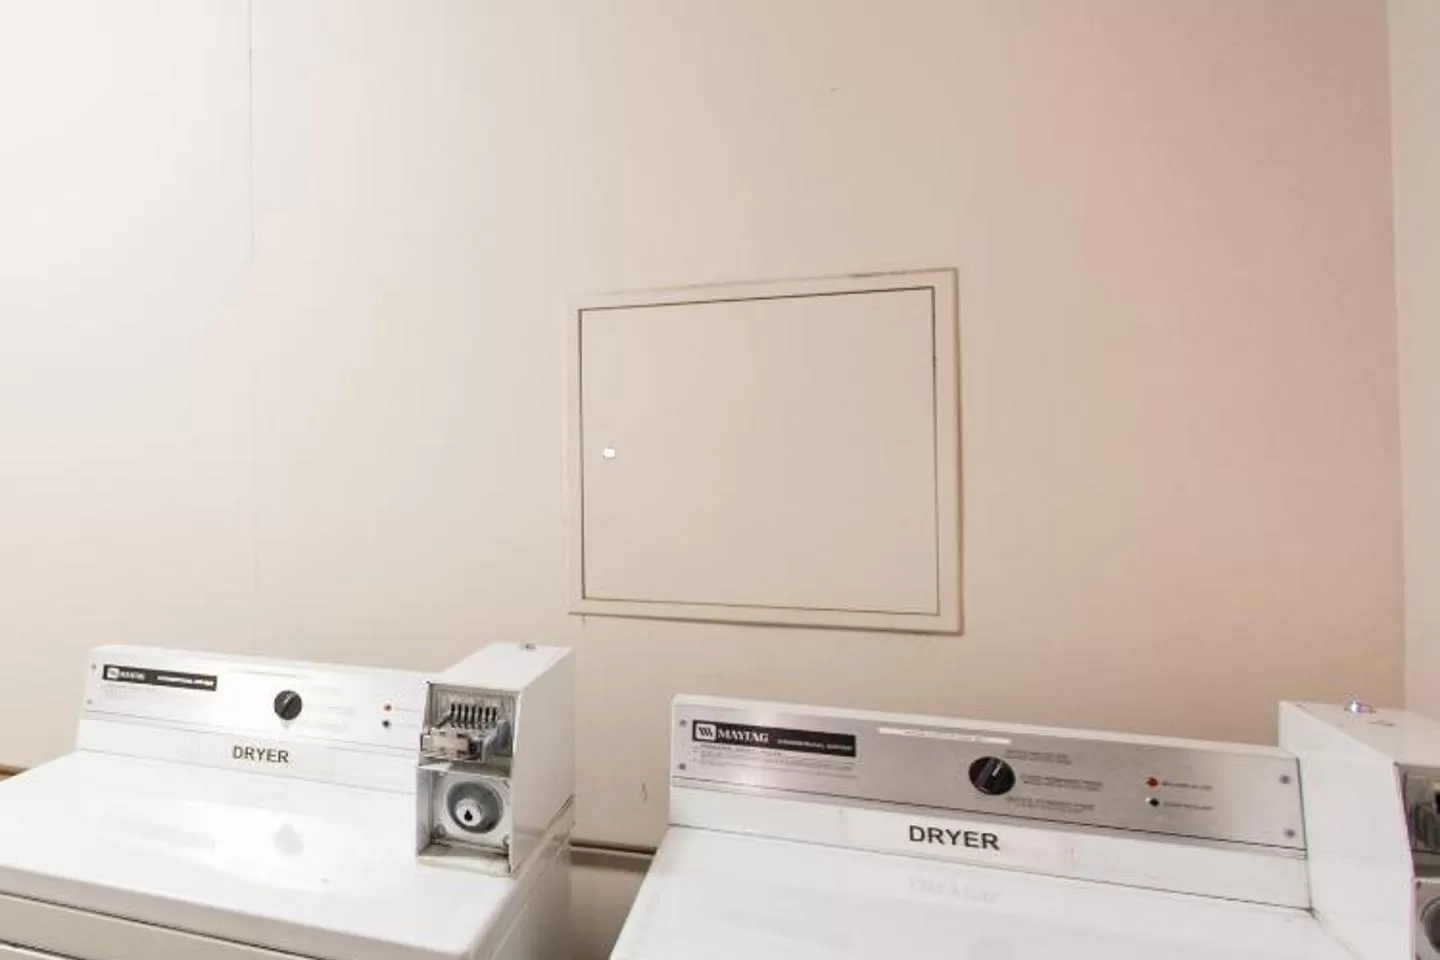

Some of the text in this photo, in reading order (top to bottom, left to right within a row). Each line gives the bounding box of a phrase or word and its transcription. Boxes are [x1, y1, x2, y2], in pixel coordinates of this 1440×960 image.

[717, 728, 769, 743] MAYTAG
[233, 745, 289, 763] DRYER
[909, 825, 1000, 850] DRYER
